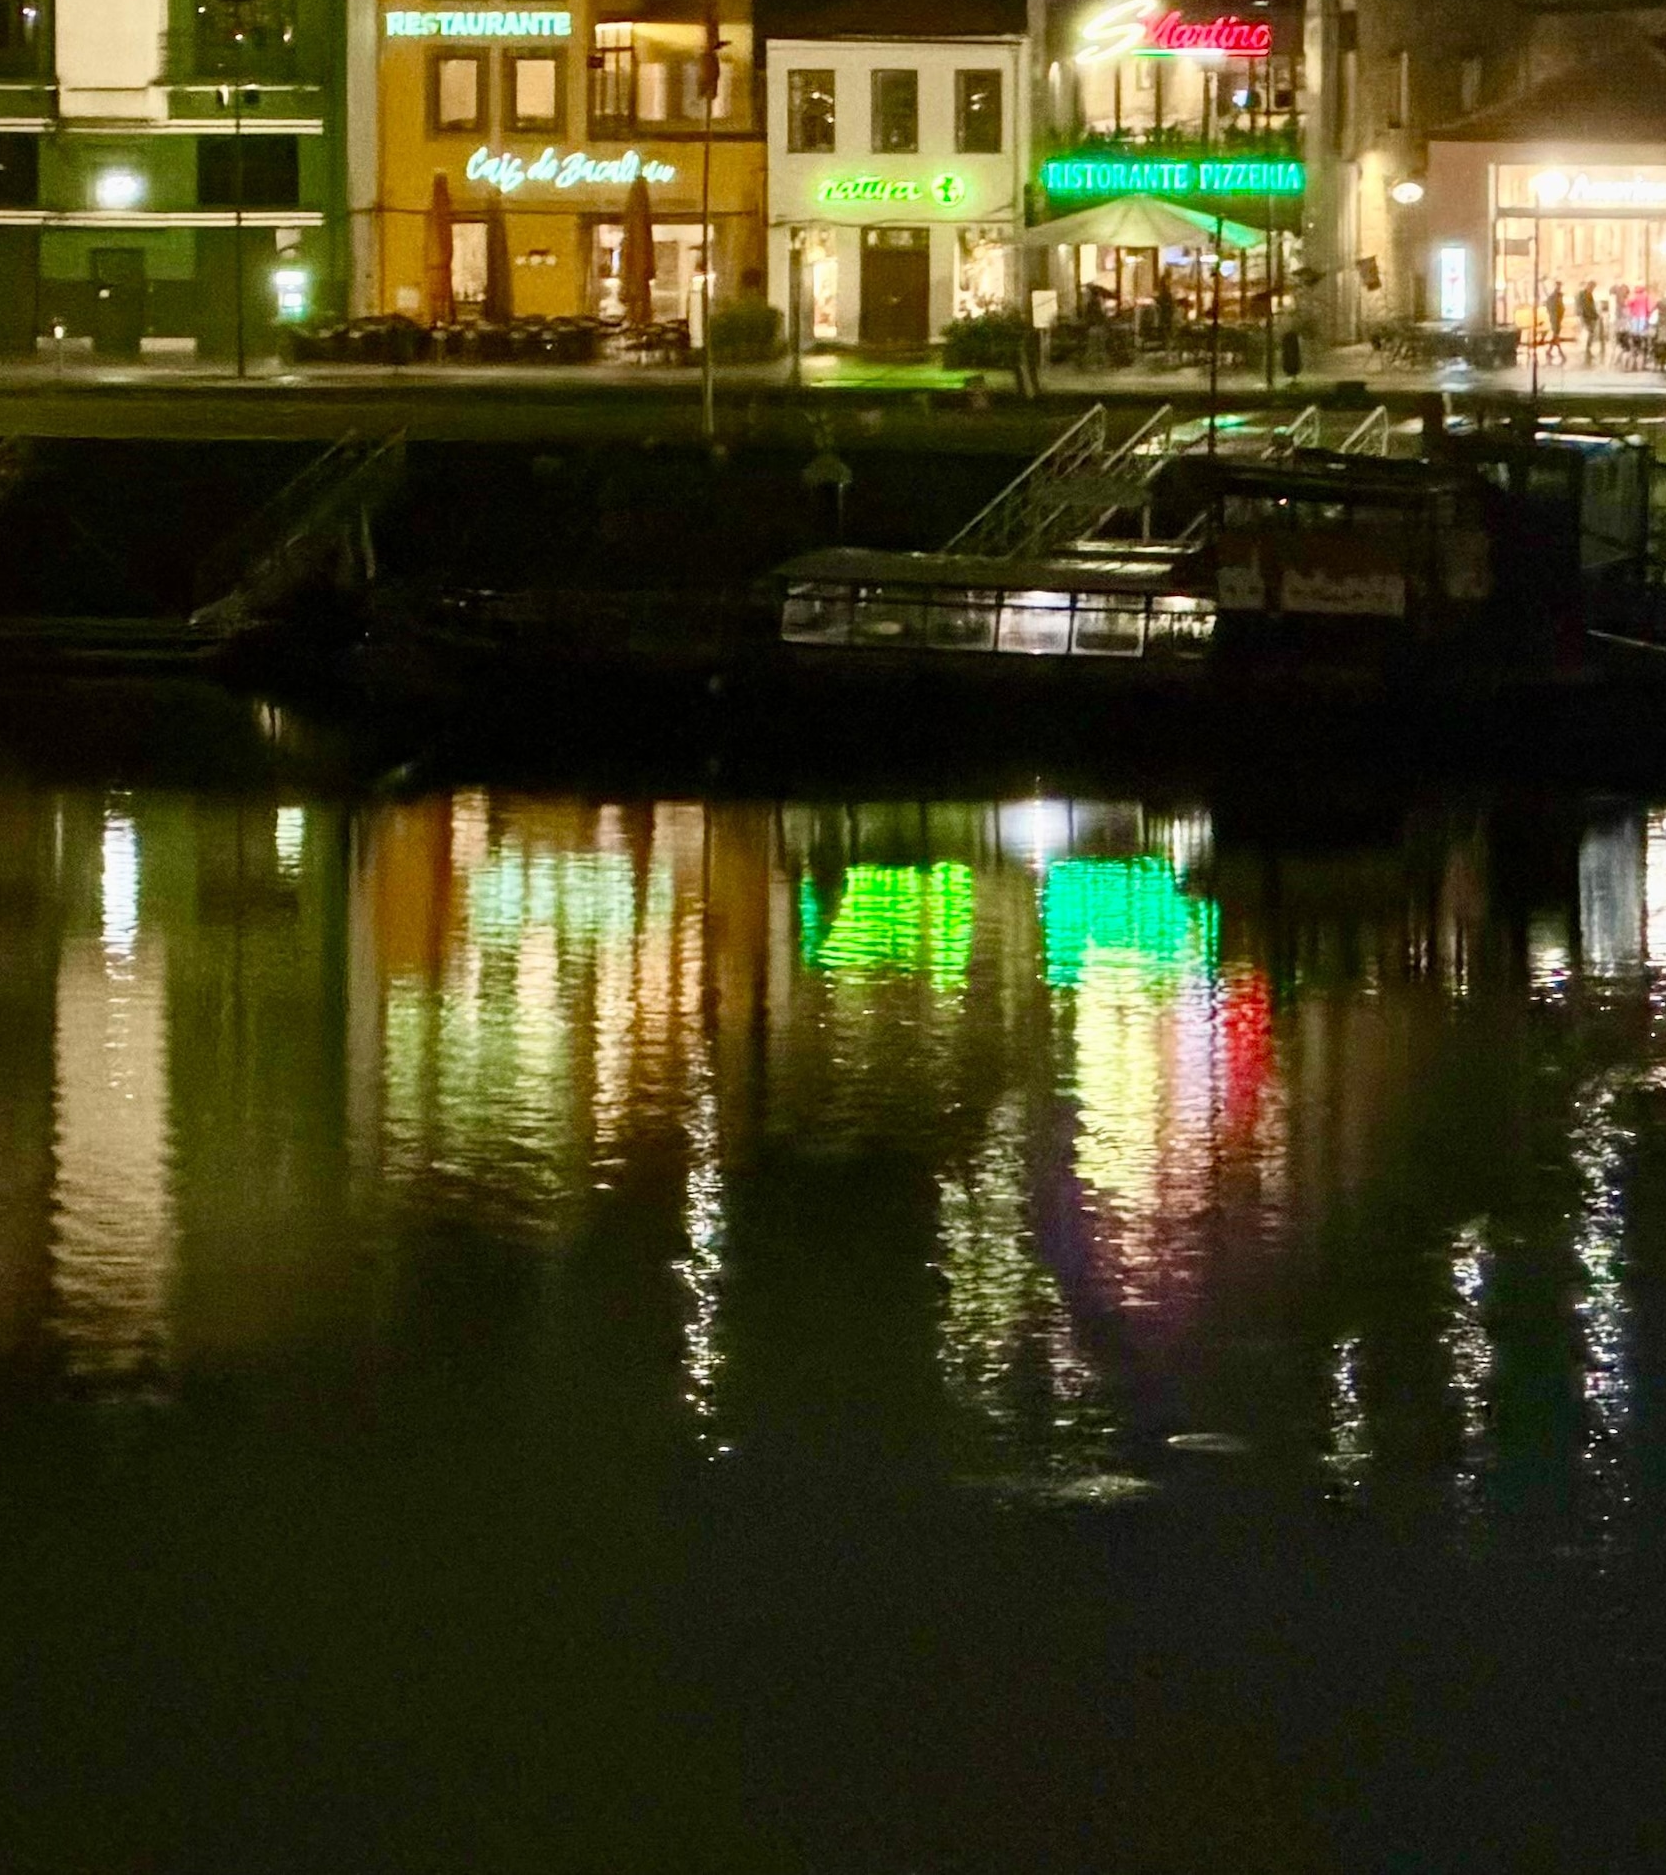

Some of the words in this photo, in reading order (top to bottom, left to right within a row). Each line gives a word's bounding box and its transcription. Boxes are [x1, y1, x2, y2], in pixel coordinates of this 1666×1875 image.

[386, 10, 572, 37] RESTAURANTE
[1047, 162, 1189, 190] RISTORANTE
[1199, 162, 1302, 190] PIZZERIA
